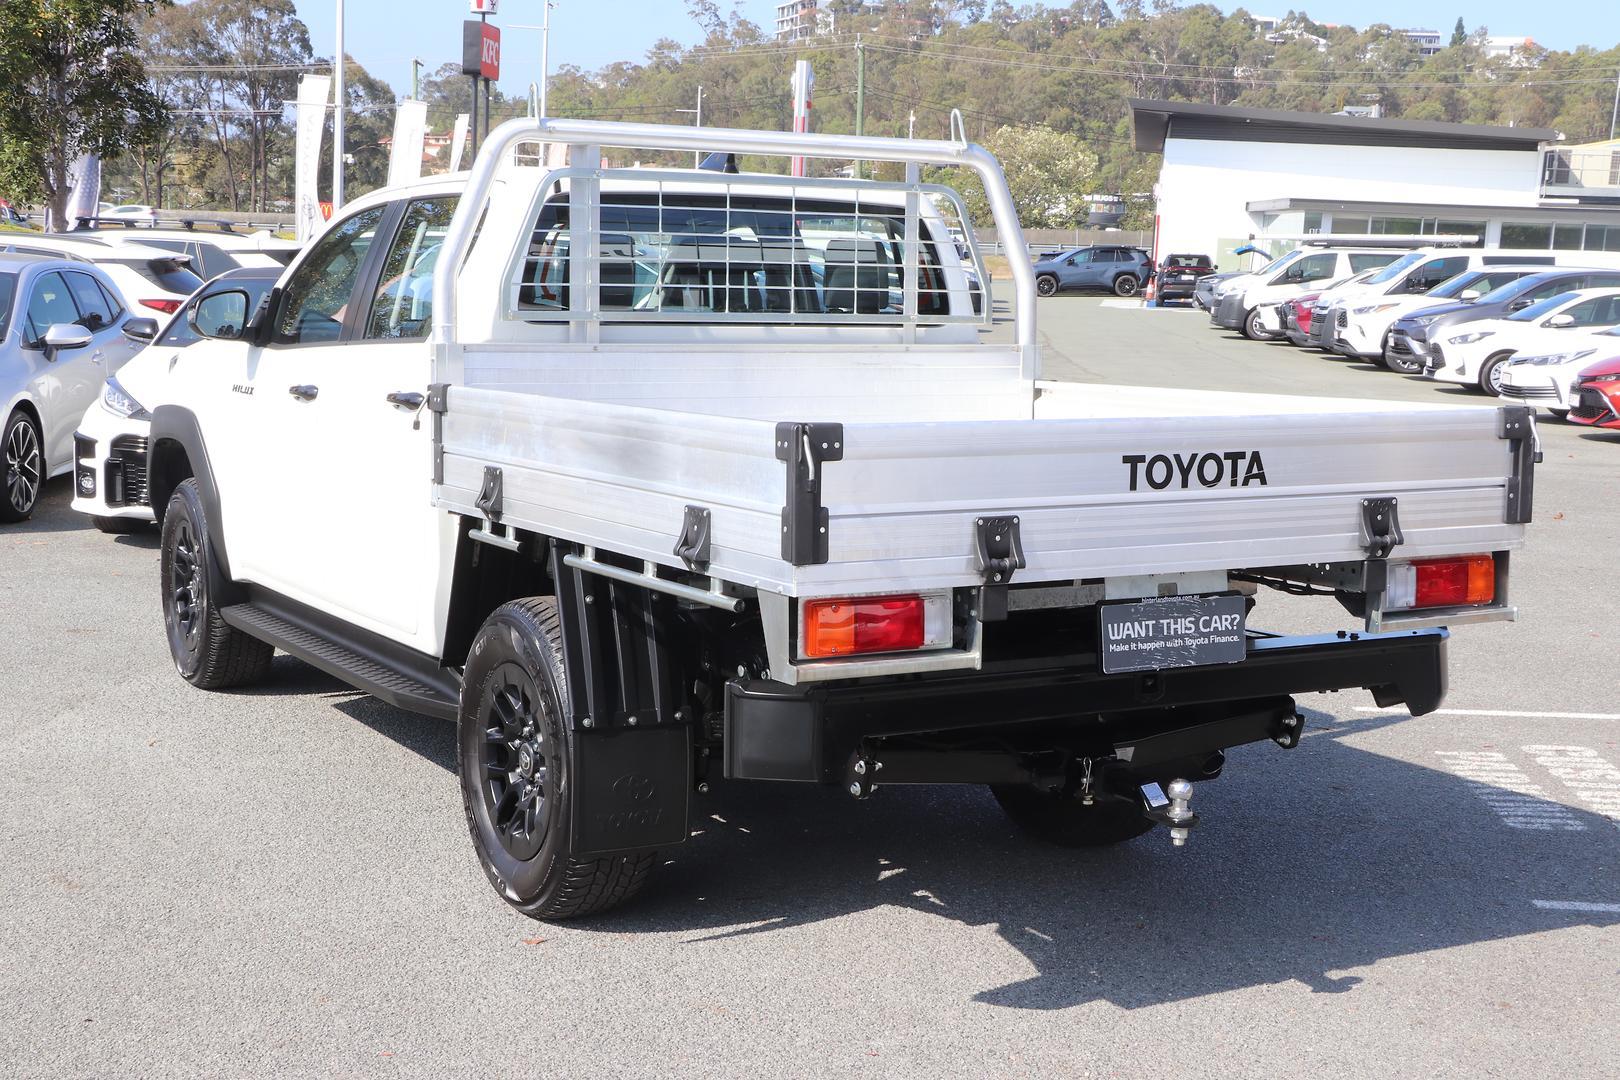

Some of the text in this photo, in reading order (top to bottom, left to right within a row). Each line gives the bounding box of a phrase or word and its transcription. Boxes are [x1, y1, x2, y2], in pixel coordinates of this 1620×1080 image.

[482, 38, 499, 65] KFC
[232, 384, 255, 396] HILUX
[1122, 451, 1268, 491] TOYOTA
[1108, 614, 1241, 640] WANT THIS CAR?
[1109, 634, 1240, 653] Make it happen with Toyota Finance.
